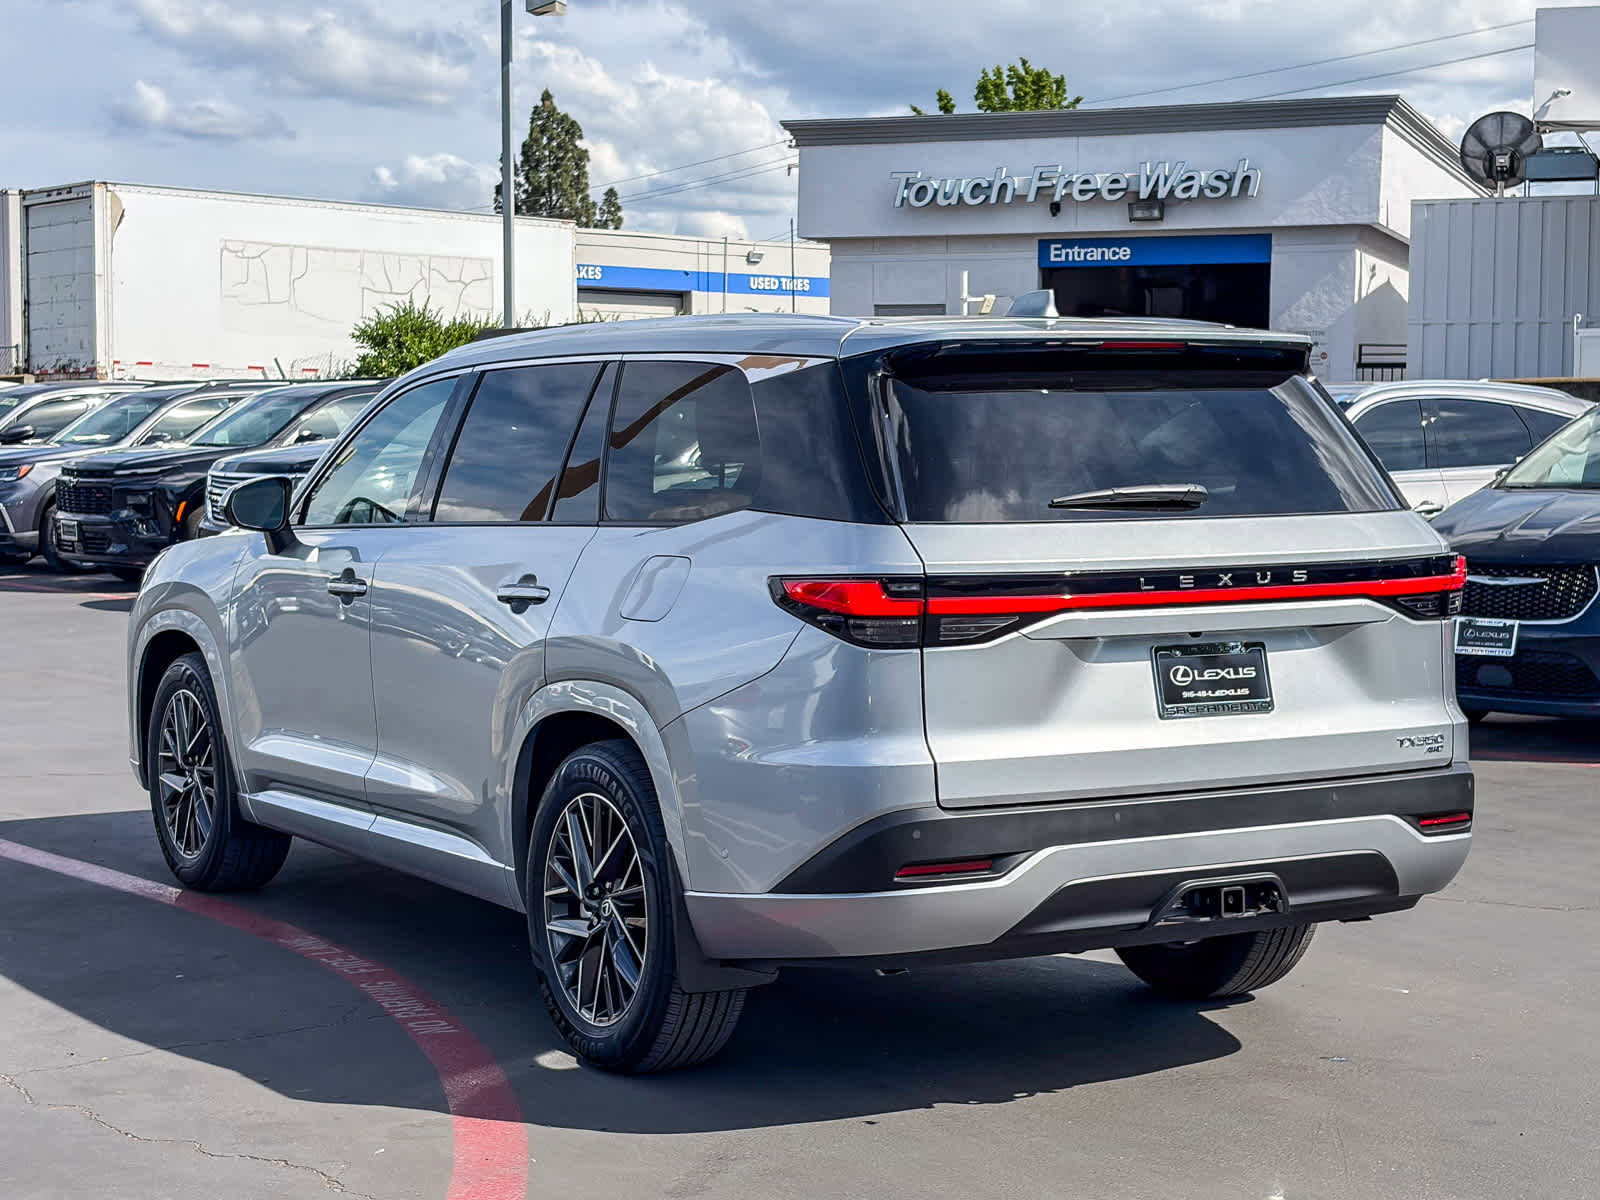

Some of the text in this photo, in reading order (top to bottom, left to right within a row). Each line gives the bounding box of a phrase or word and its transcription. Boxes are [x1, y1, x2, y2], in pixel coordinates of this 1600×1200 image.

[889, 158, 1263, 208] Touch Free Wash
[1049, 244, 1132, 263] Entrance
[749, 275, 779, 291] USED
[1139, 569, 1308, 590] LEXUS
[1194, 666, 1257, 681] LEXUS
